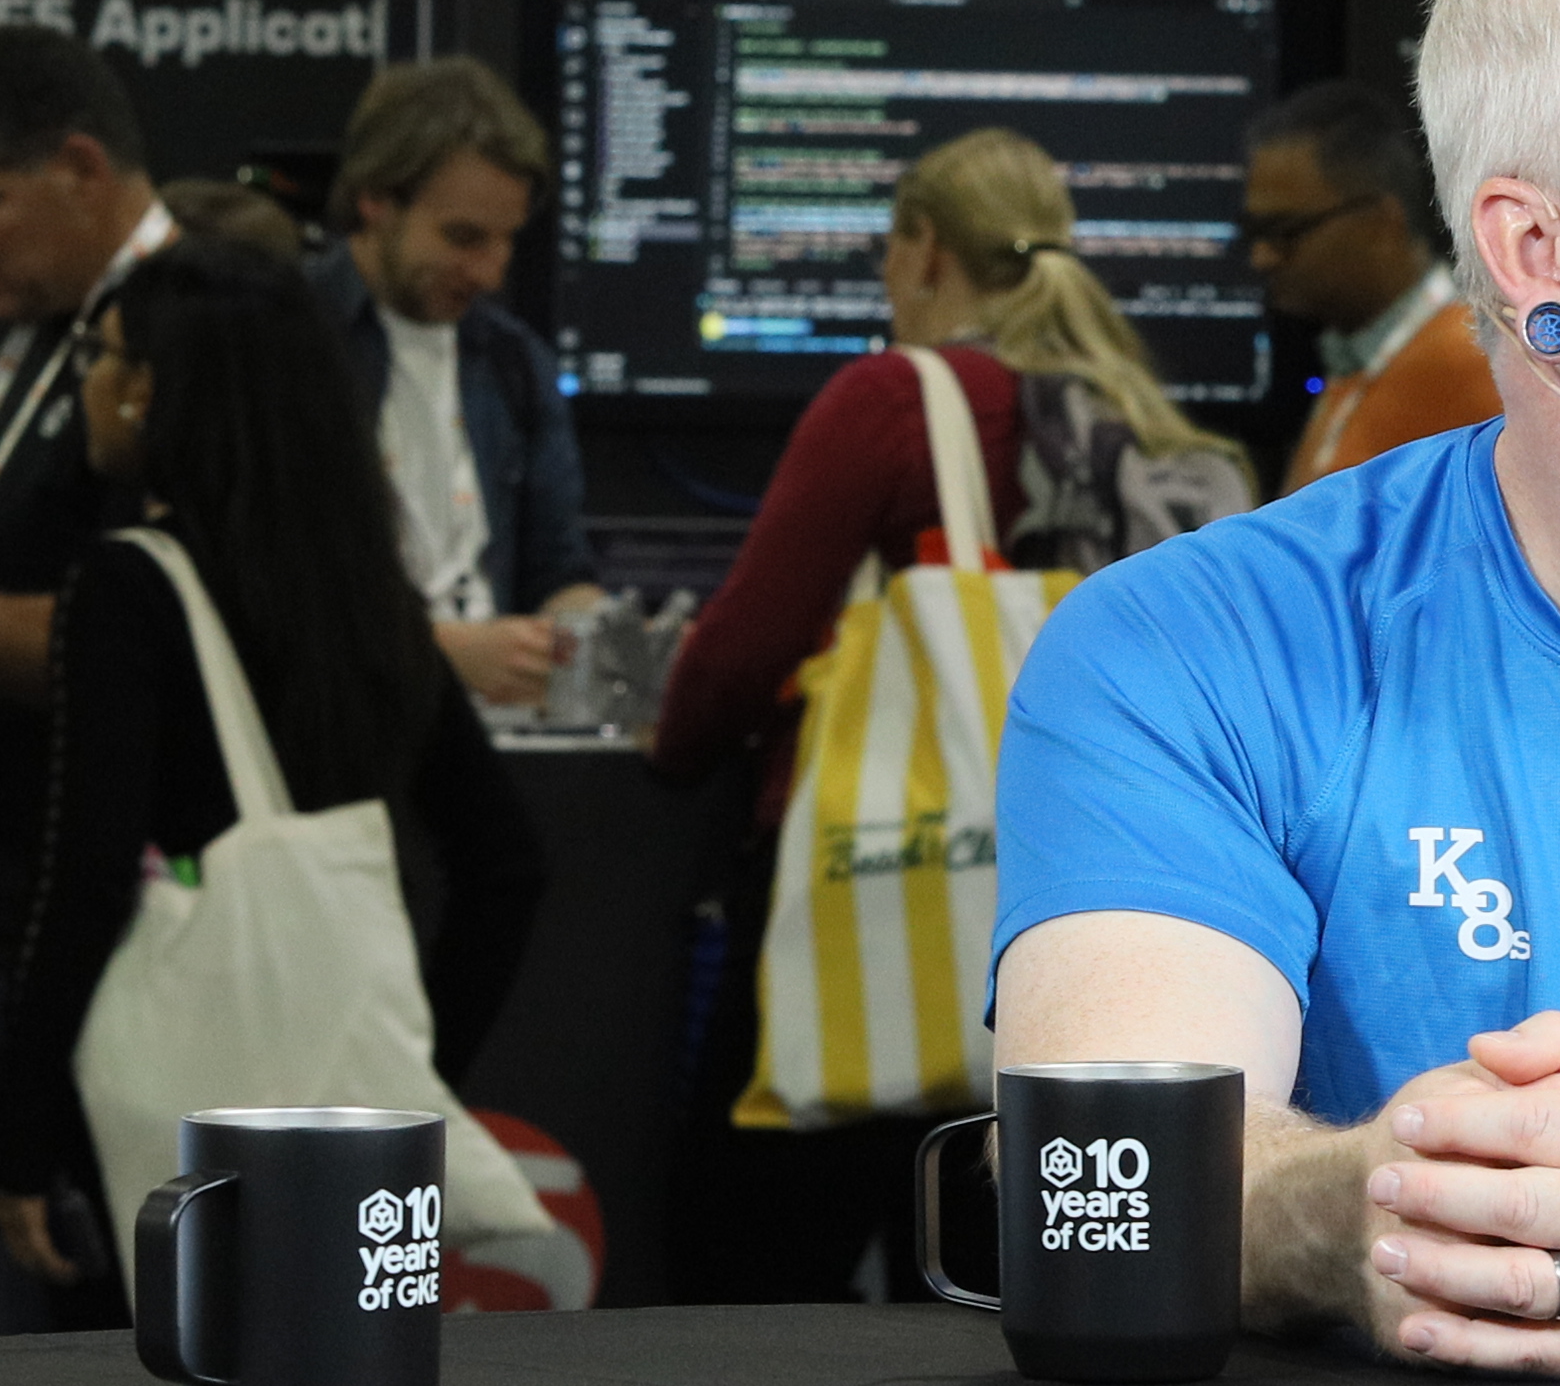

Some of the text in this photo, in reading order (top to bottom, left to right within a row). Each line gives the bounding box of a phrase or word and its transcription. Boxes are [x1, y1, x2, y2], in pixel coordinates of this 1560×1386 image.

[1085, 1137, 1151, 1190] 10
[404, 1184, 441, 1240] 10
[1041, 1190, 1151, 1227] years
[1042, 1221, 1151, 1252] of GKE
[358, 1239, 440, 1286] years
[358, 1271, 440, 1311] of GKE
